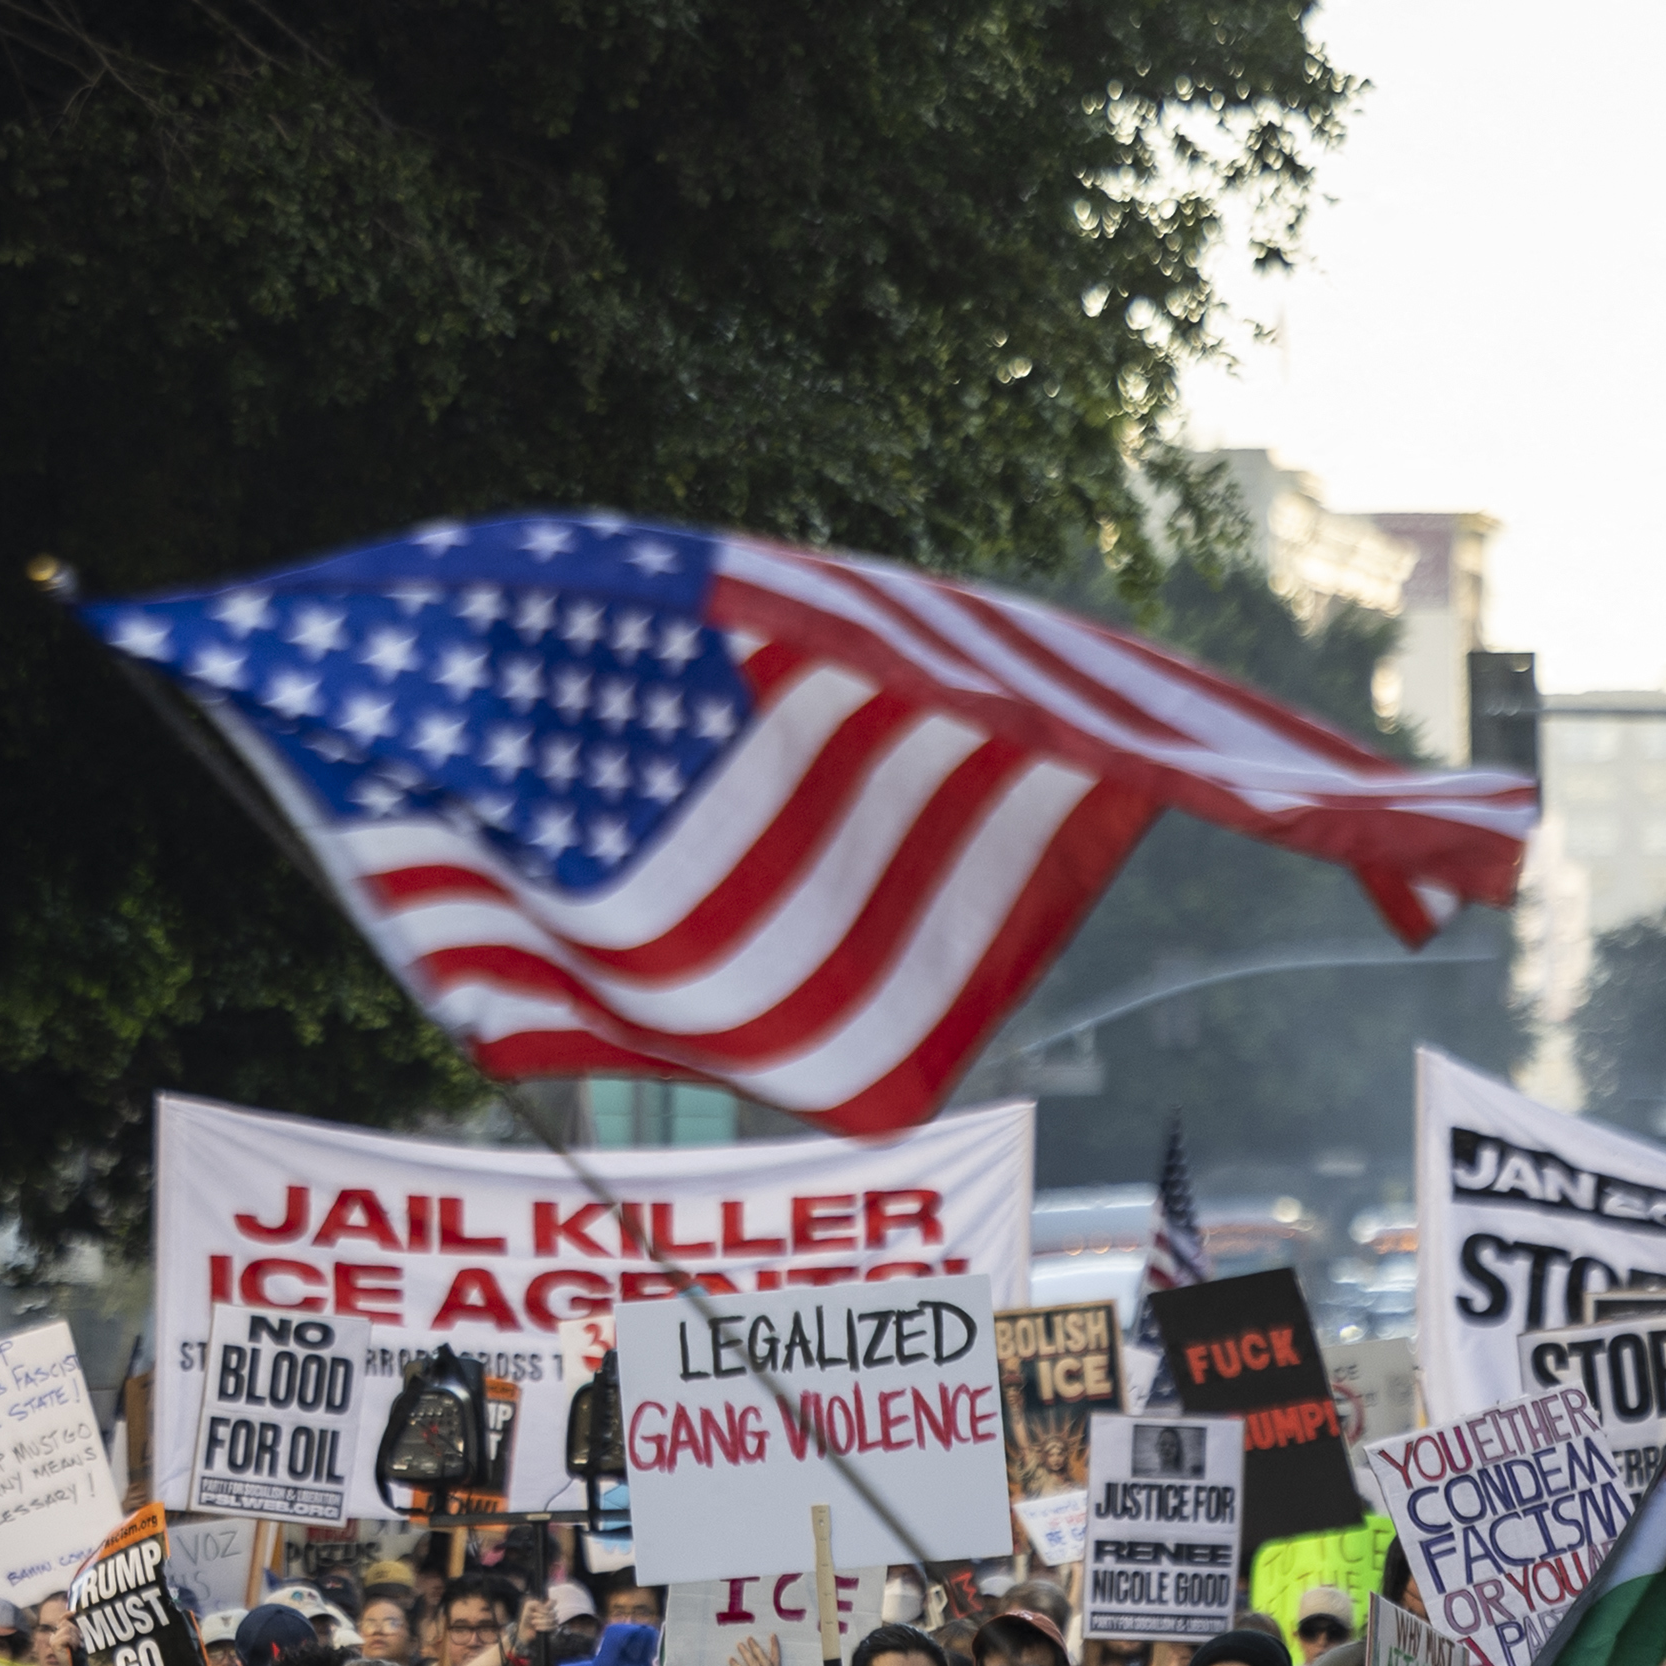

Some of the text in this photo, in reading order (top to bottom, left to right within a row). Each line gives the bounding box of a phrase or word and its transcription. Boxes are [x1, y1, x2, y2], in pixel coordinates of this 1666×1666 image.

[1453, 1143, 1599, 1211] JAN
[234, 1185, 944, 1260] JAIL KILLER
[209, 1254, 404, 1327] ICE
[248, 1315, 334, 1351] NO
[679, 1300, 978, 1382] LEGALIZED
[996, 1310, 1109, 1361] BOLISH
[1185, 1327, 1300, 1385] FUCK
[218, 1344, 354, 1415] BLOOD
[1038, 1354, 1112, 1403] ICE
[12, 1432, 61, 1462] MUST
[63, 1423, 93, 1446] GO
[203, 1415, 345, 1485] FOR OIL
[629, 1381, 998, 1473] GANG VIOLENCE
[1378, 1388, 1603, 1490] YOU EITHER
[32, 1448, 98, 1480] MEANS
[202, 1477, 228, 1491] PARTY
[287, 1487, 297, 1500] &
[1407, 1436, 1618, 1535] CONDEM
[199, 1491, 339, 1519] PSLWEB.ORG
[1095, 1483, 1191, 1521] JUSTICE
[1194, 1486, 1235, 1523] FOR
[1094, 1540, 1233, 1566] RENEE
[1419, 1482, 1632, 1595] FACISM
[75, 1586, 170, 1655] MUST
[1093, 1570, 1230, 1608] NICOLE GOOD
[1444, 1578, 1516, 1635] OR
[1506, 1550, 1590, 1613] YOU
[1394, 1608, 1422, 1660] WHY
